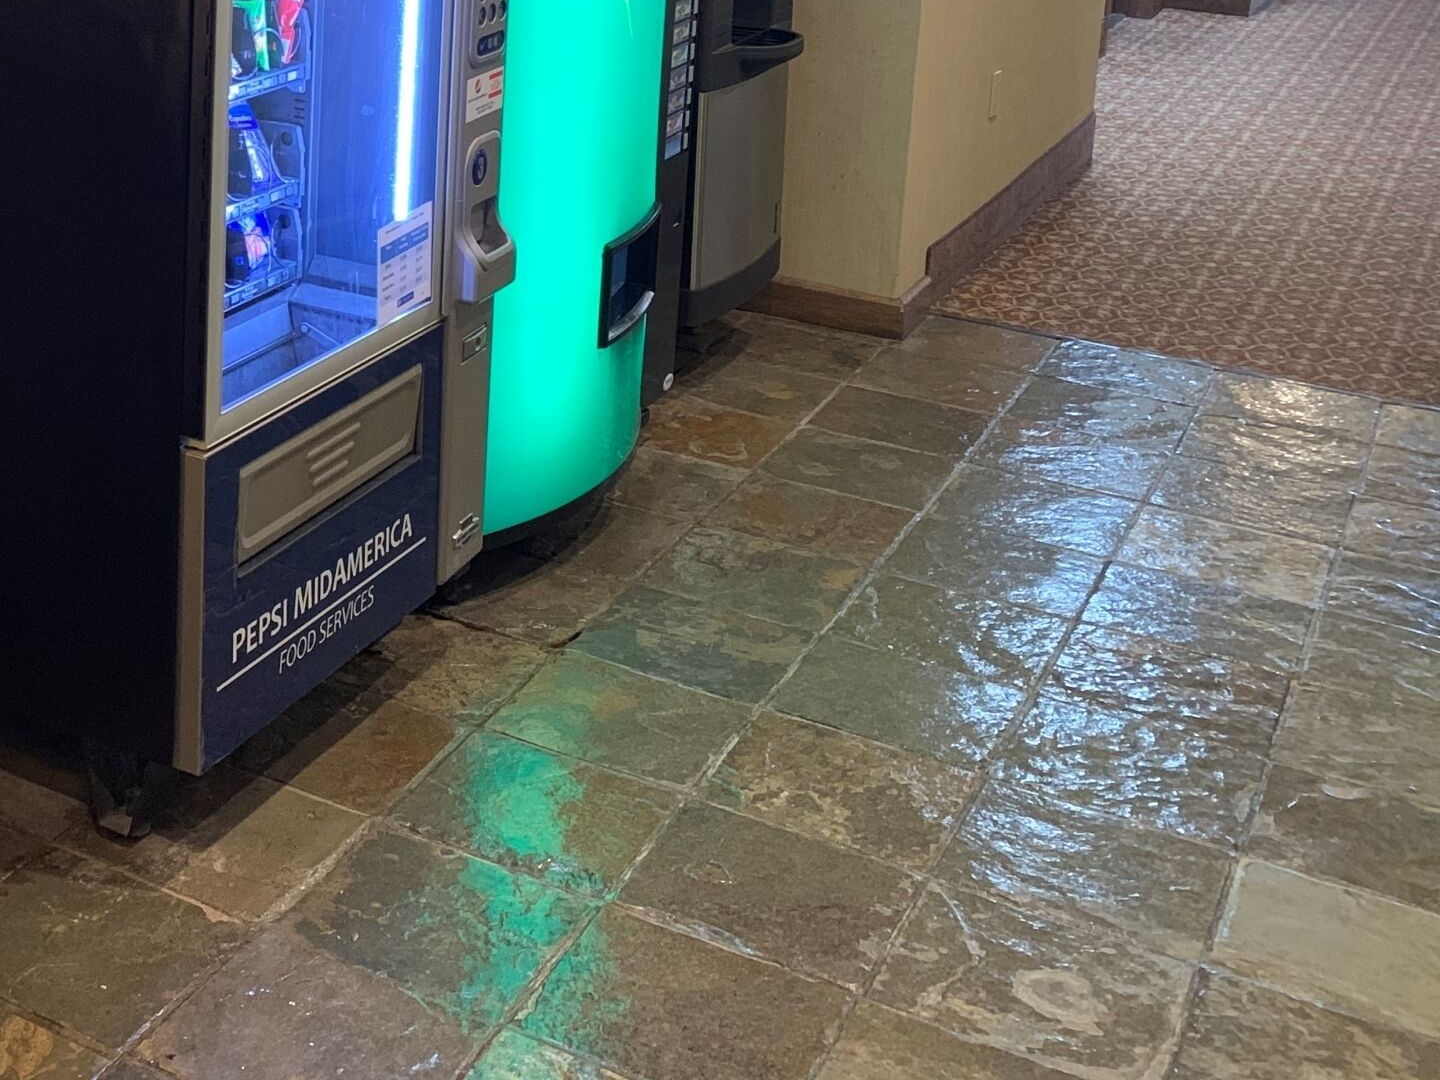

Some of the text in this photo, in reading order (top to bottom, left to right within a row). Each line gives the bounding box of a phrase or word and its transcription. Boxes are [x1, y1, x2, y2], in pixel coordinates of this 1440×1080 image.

[232, 513, 413, 664] PEPSI MIDAMERICA
[278, 585, 375, 675] FOOD SERVICES
